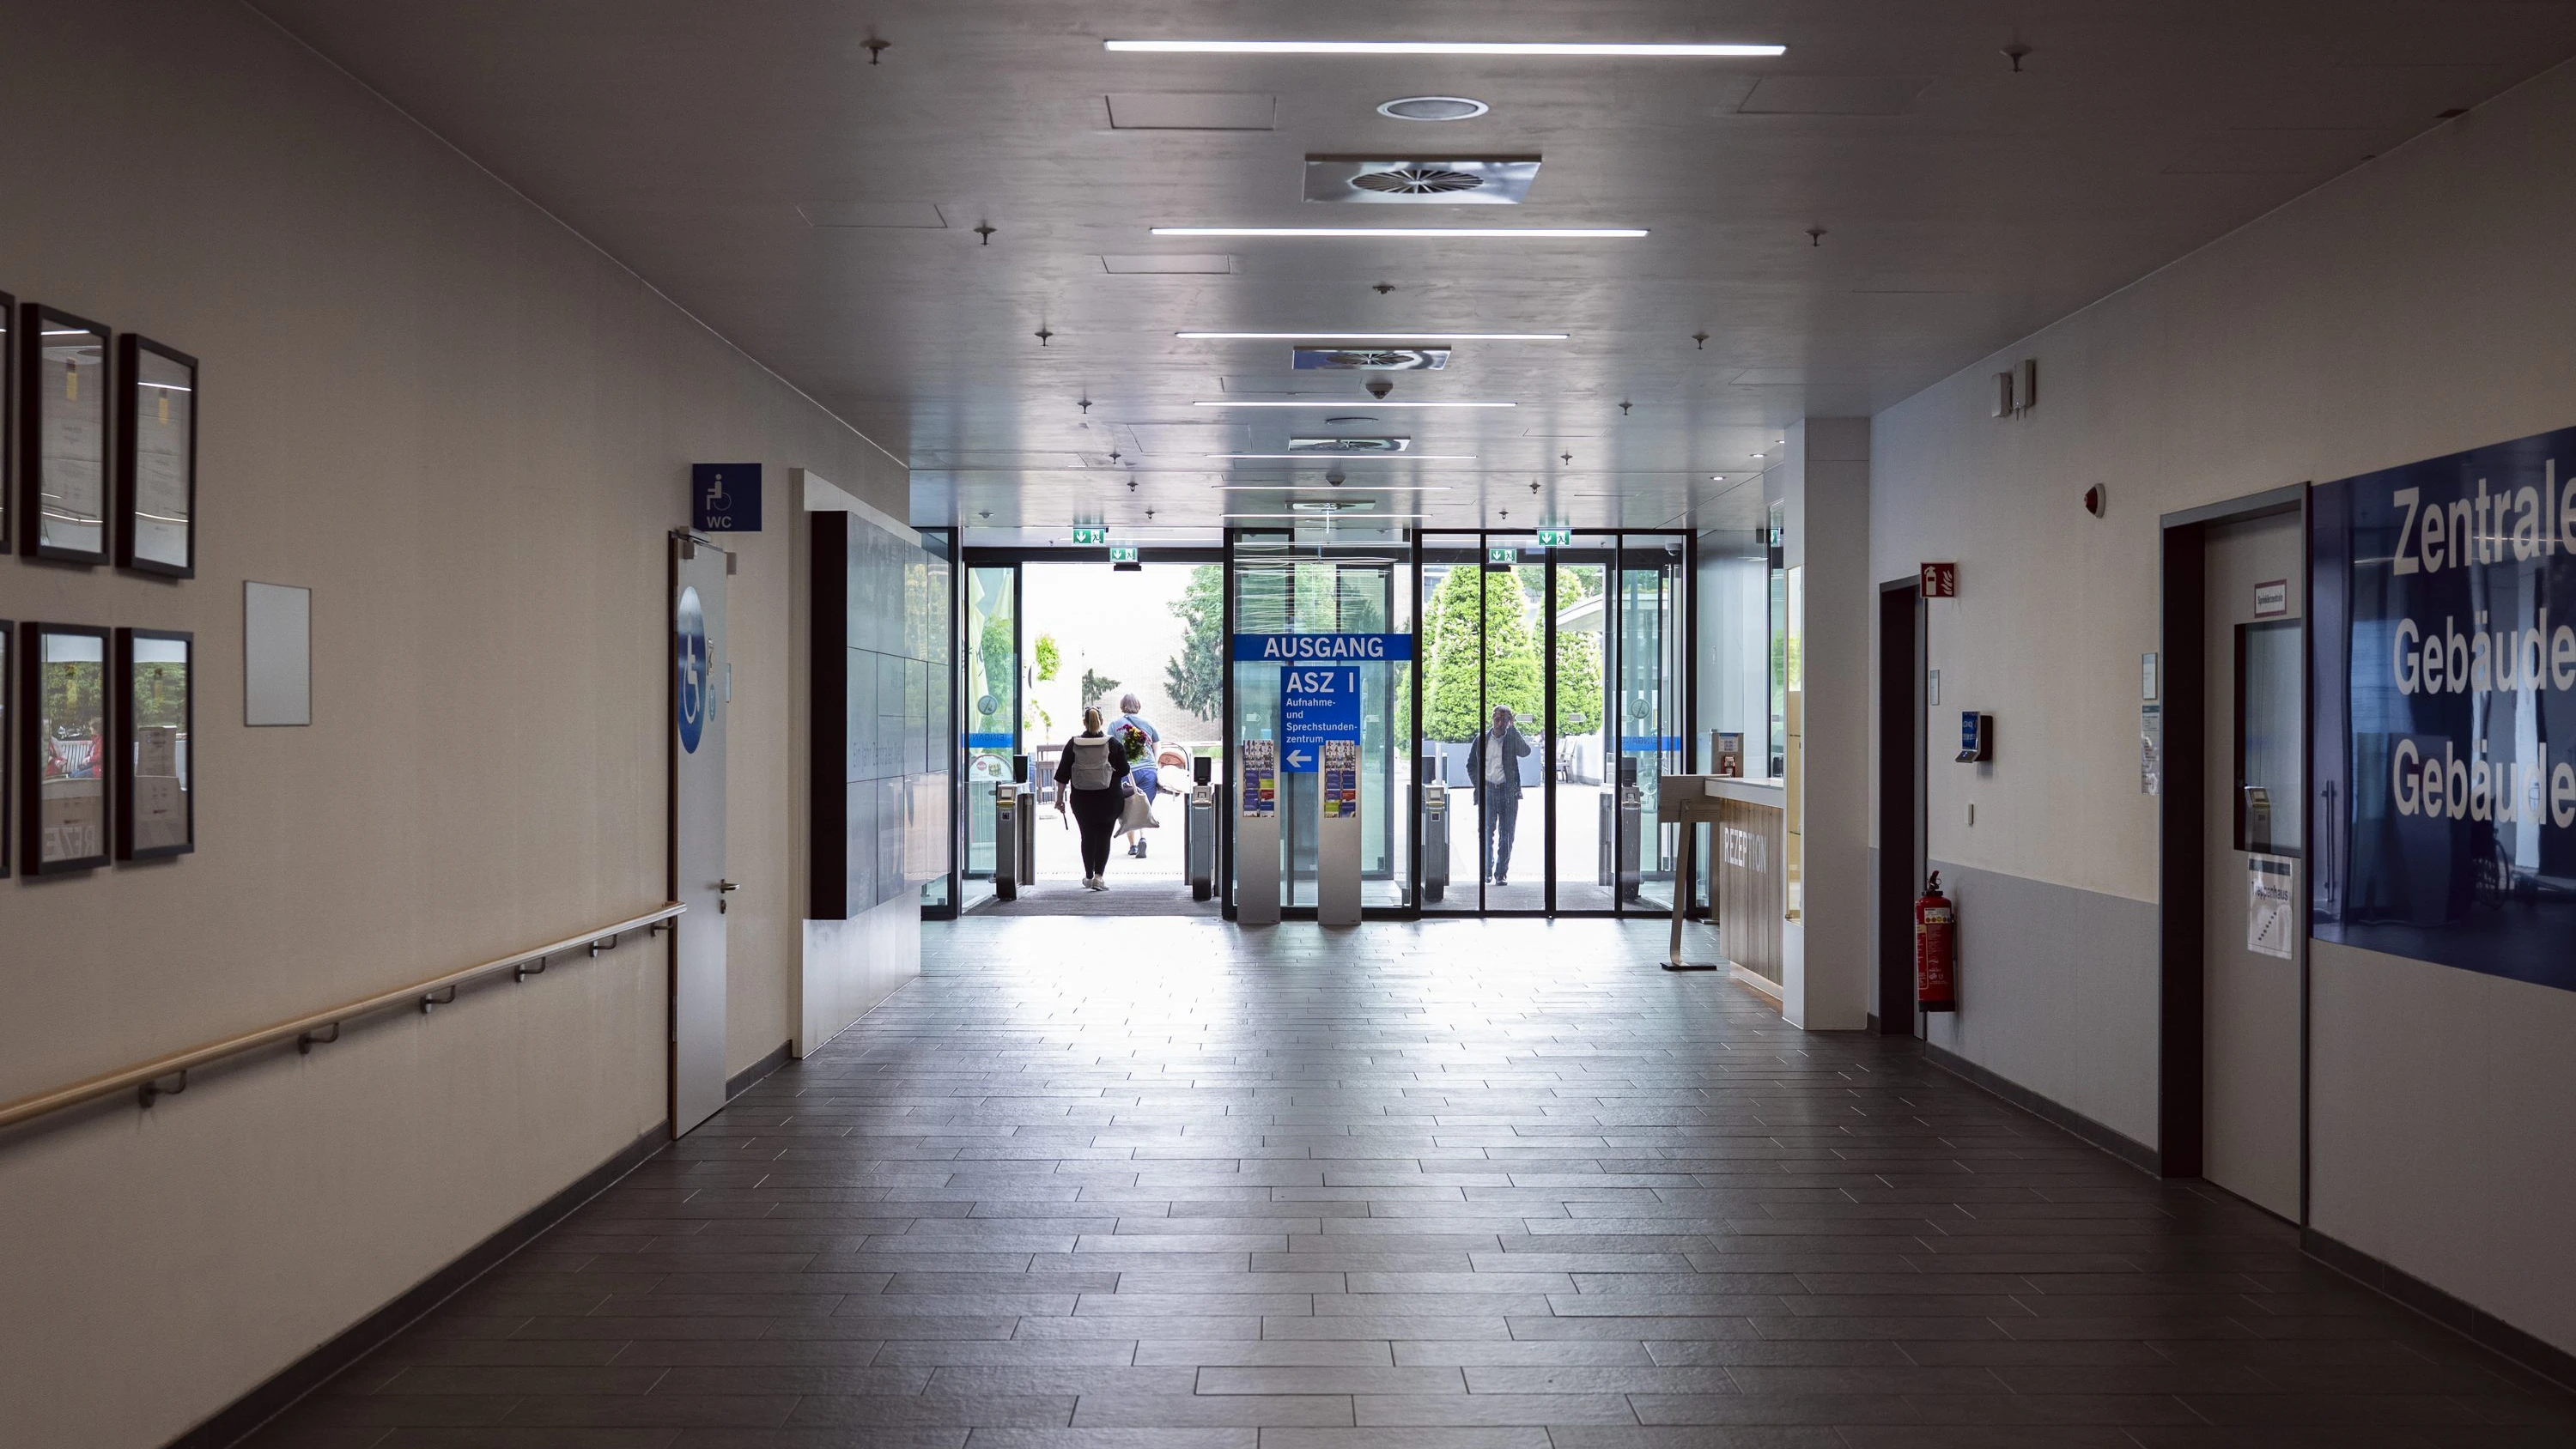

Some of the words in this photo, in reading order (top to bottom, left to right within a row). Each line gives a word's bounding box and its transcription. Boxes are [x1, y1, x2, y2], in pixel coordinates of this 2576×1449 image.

[707, 516, 732, 529] WC
[1263, 637, 1383, 658] AUSGANG
[2392, 607, 2576, 695] Gebäude
[1286, 671, 1334, 693] ASZ
[1348, 672, 1354, 693] I
[1286, 698, 1336, 707] Aufnahme-
[1286, 710, 1303, 718] und
[1286, 723, 1358, 733] Sprechstunden-
[2392, 738, 2576, 829] Gebäude
[1724, 827, 1766, 874] REZEPTION
[2251, 880, 2288, 901] eppenhaus
